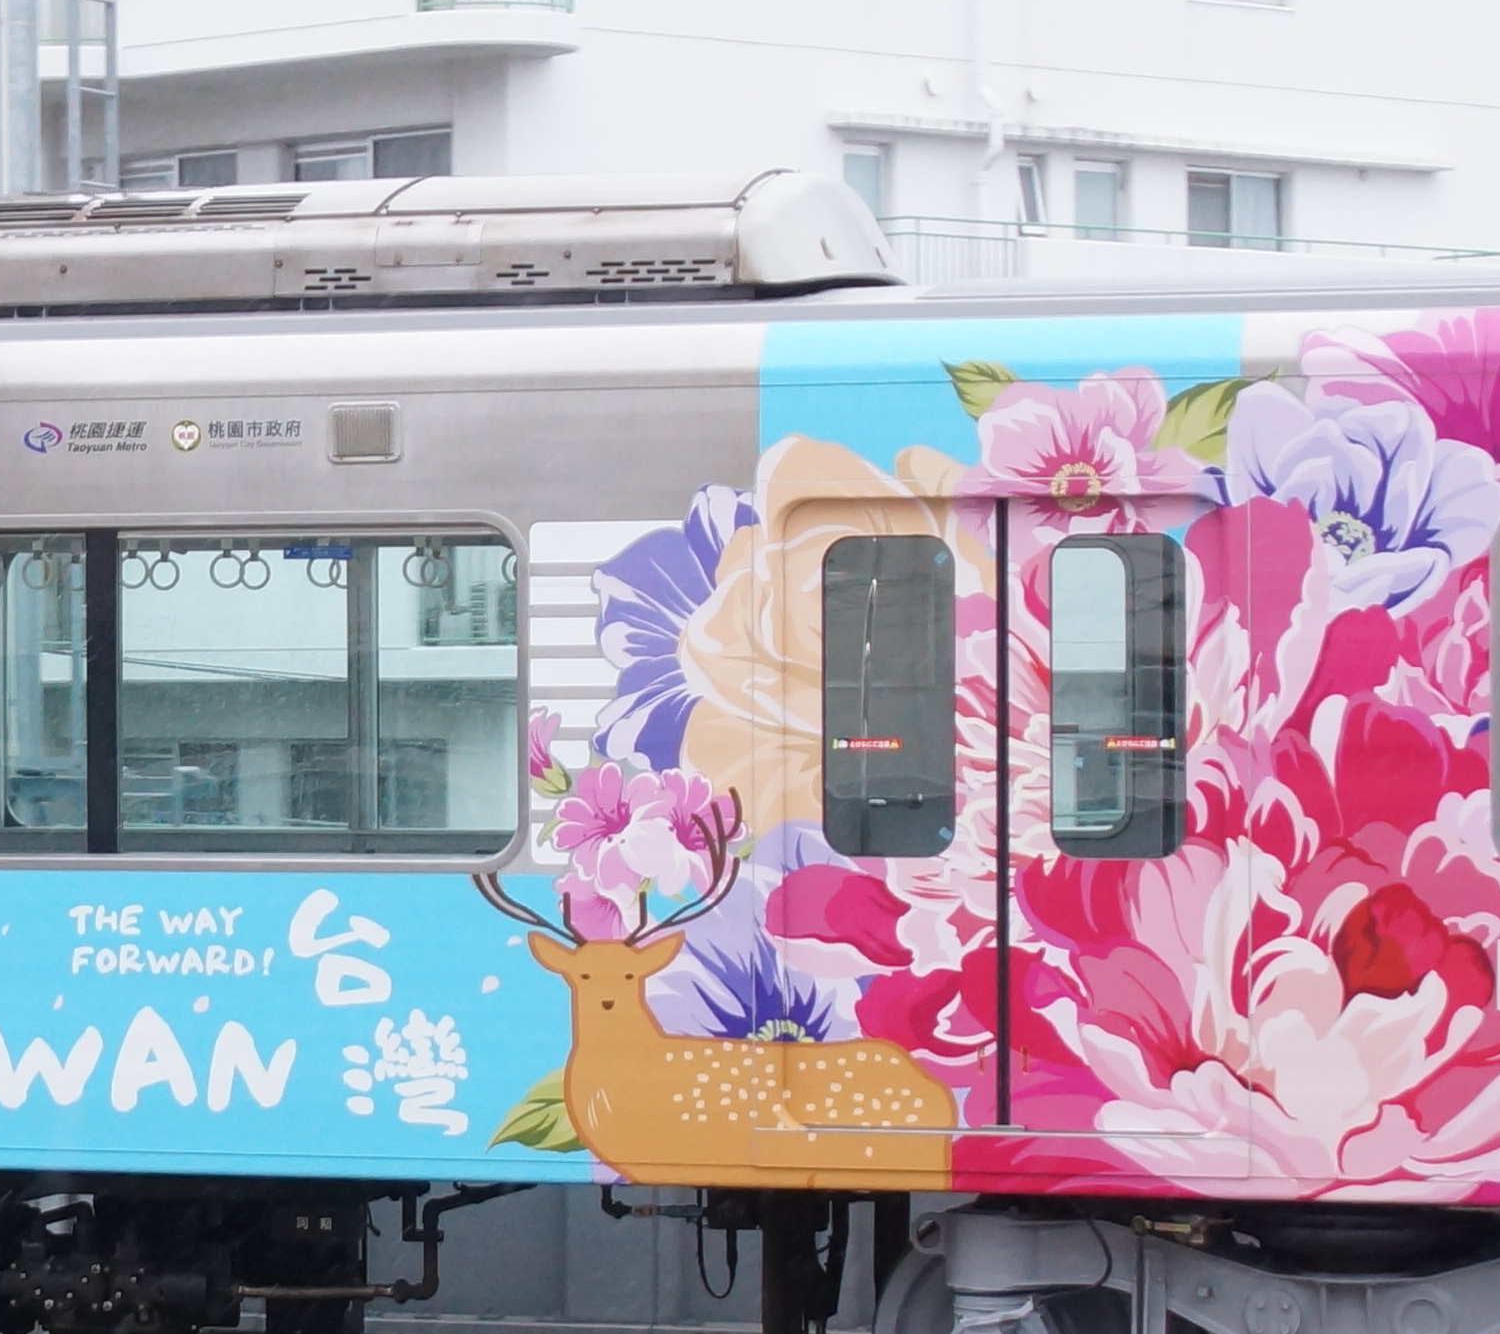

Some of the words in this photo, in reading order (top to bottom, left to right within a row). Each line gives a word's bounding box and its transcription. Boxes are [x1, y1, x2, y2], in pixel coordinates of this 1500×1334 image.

[68, 421, 147, 440] 桃園捷運
[207, 419, 303, 439] 桃園市政府
[66, 441, 112, 454] Taoyuan
[116, 441, 147, 453] Metro
[68, 904, 143, 936] THE
[159, 905, 244, 936] WAY
[70, 945, 274, 977] FORWARD!
